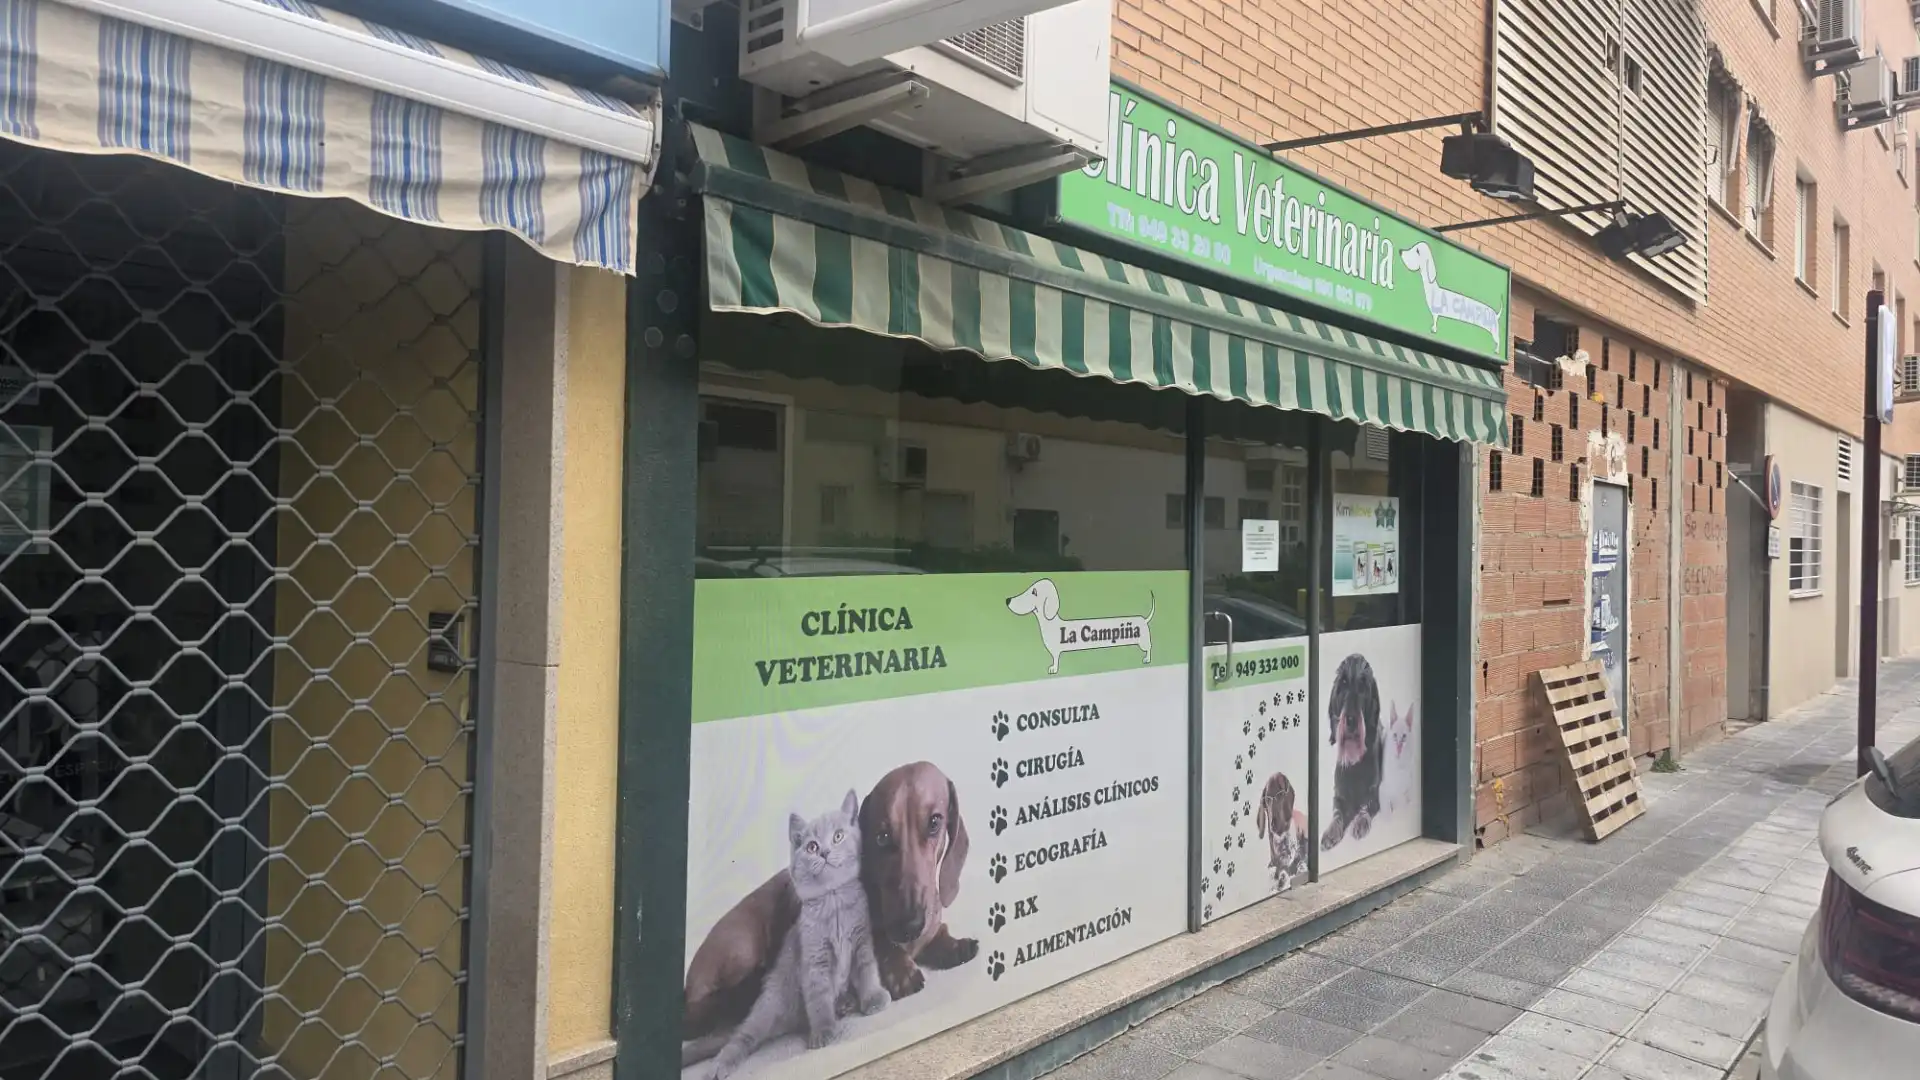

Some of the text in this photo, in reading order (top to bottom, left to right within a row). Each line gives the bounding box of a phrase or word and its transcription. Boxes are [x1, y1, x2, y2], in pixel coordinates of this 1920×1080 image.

[1081, 90, 1395, 291] línica Veterinaria
[801, 602, 913, 637] CLÍNICA
[1060, 622, 1141, 644] La Campiña
[755, 645, 947, 687] VETERINARIA
[1236, 660, 1256, 678] 949
[1258, 657, 1279, 675] 332
[1281, 654, 1299, 669] 000
[1016, 703, 1100, 732] CONSULTA
[1016, 746, 1085, 778] CIRUGÍA
[1015, 776, 1159, 826] ANÁLISIS CLÍNICOS
[1014, 828, 1108, 873] ECOGRAFÍA
[1013, 895, 1039, 920] RX
[1013, 907, 1133, 967] ALIMENTACIÓN
